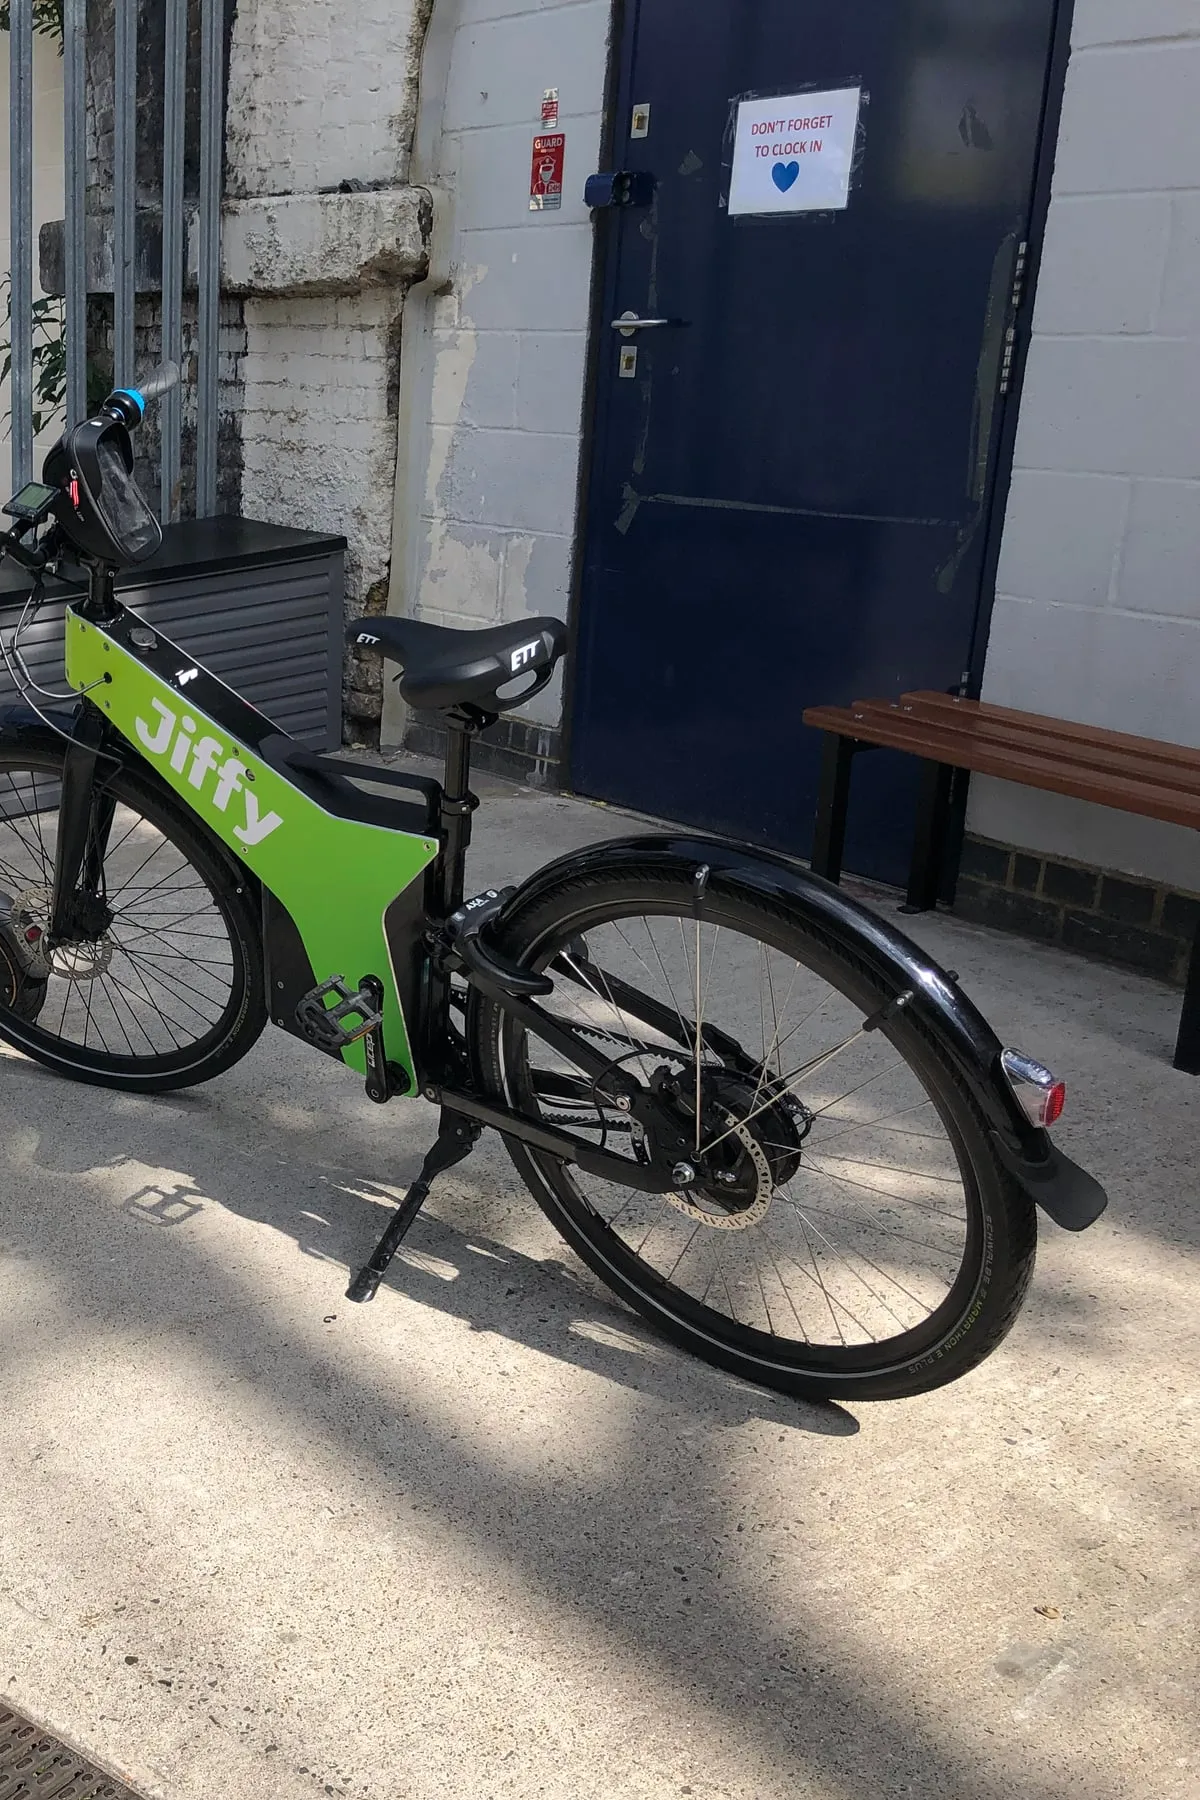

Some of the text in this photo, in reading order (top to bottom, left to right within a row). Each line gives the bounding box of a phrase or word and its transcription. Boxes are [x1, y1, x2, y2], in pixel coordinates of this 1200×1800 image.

[751, 115, 833, 135] DON'T FORGET
[534, 137, 563, 149] GUARD
[755, 140, 822, 158] TO CLOCK IN
[356, 633, 381, 644] ETT
[511, 639, 540, 672] ETT
[135, 696, 284, 846] Jiffy
[983, 1215, 994, 1285] SCHWALBE
[944, 1301, 983, 1352] MARATHON
[908, 1356, 939, 1375] PLUS
